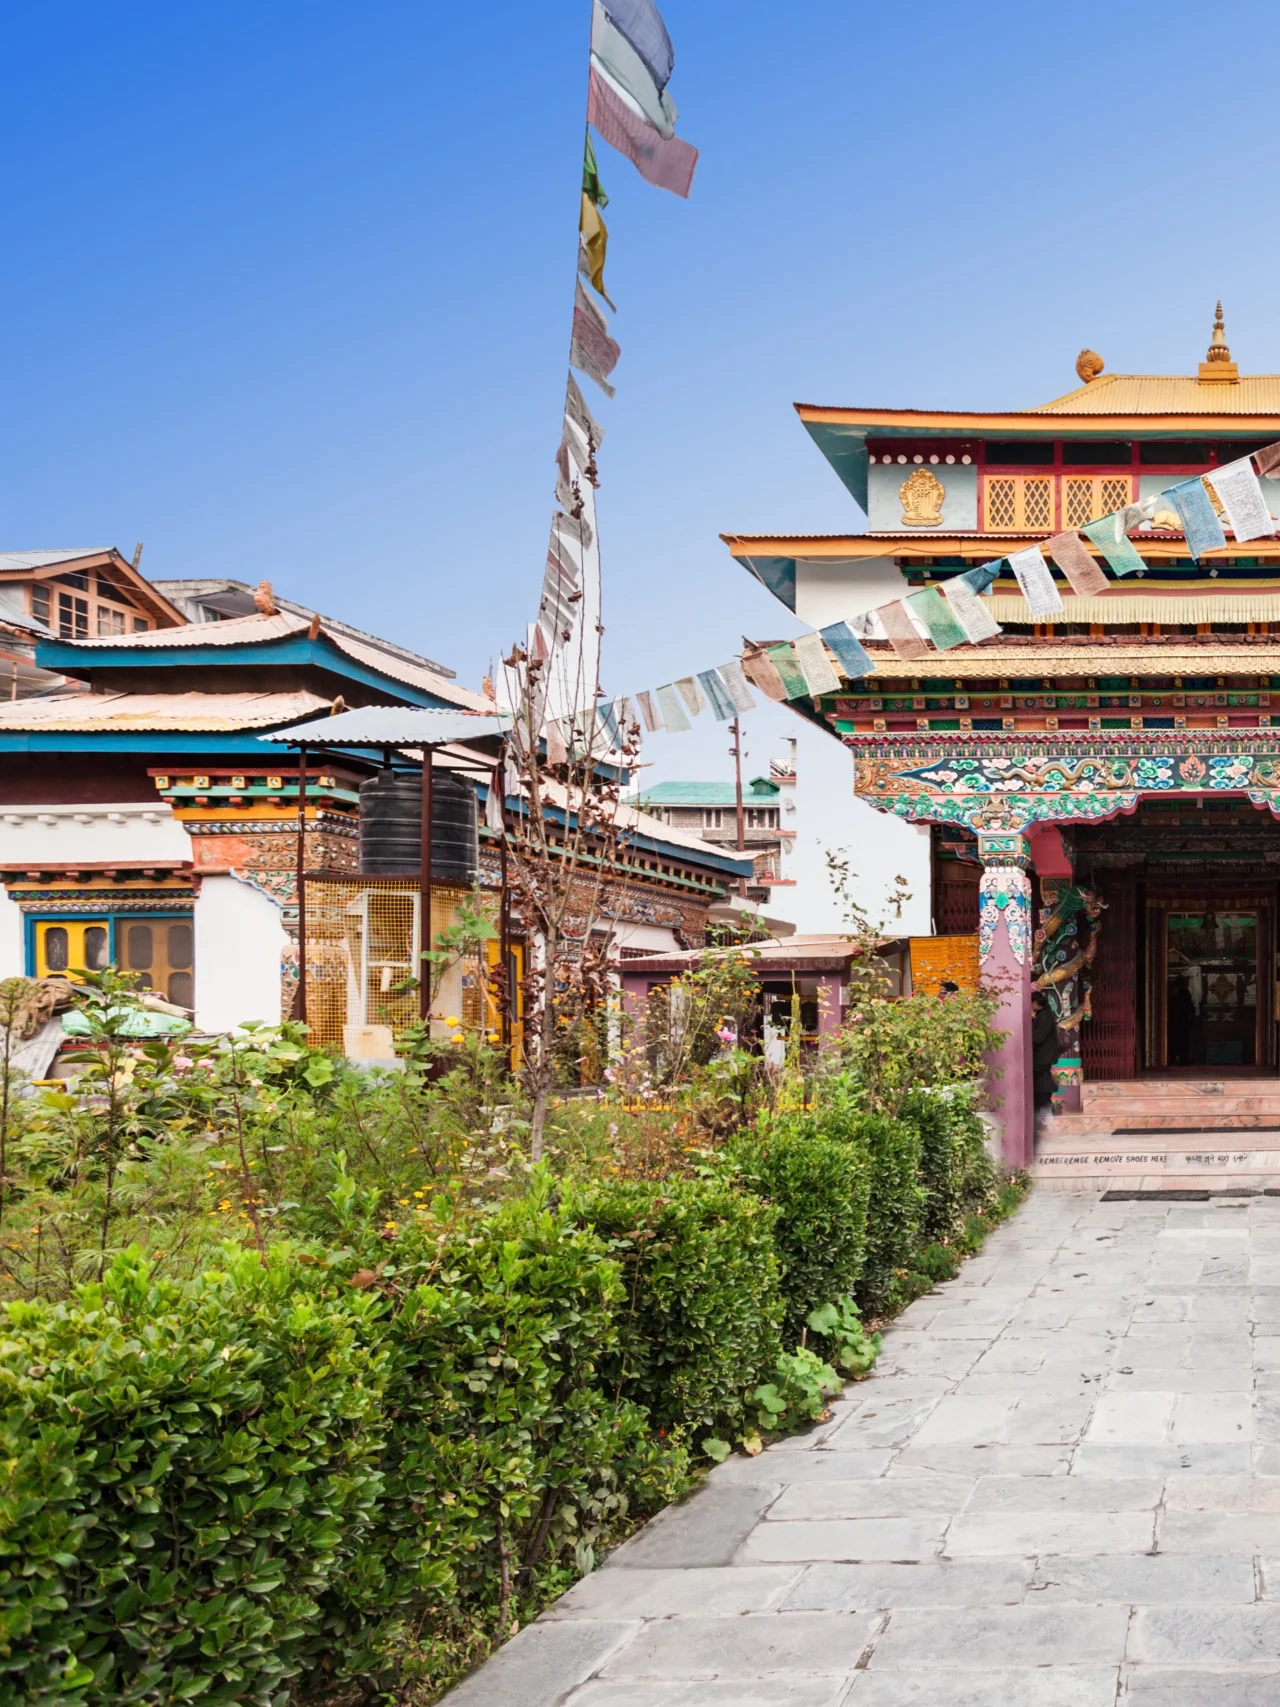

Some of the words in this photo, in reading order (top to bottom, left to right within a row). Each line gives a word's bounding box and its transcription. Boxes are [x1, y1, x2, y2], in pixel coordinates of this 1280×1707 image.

[1093, 1155, 1124, 1165] REMOVE
[1126, 1155, 1149, 1164] SHOES
[1150, 1155, 1168, 1164] HERE
